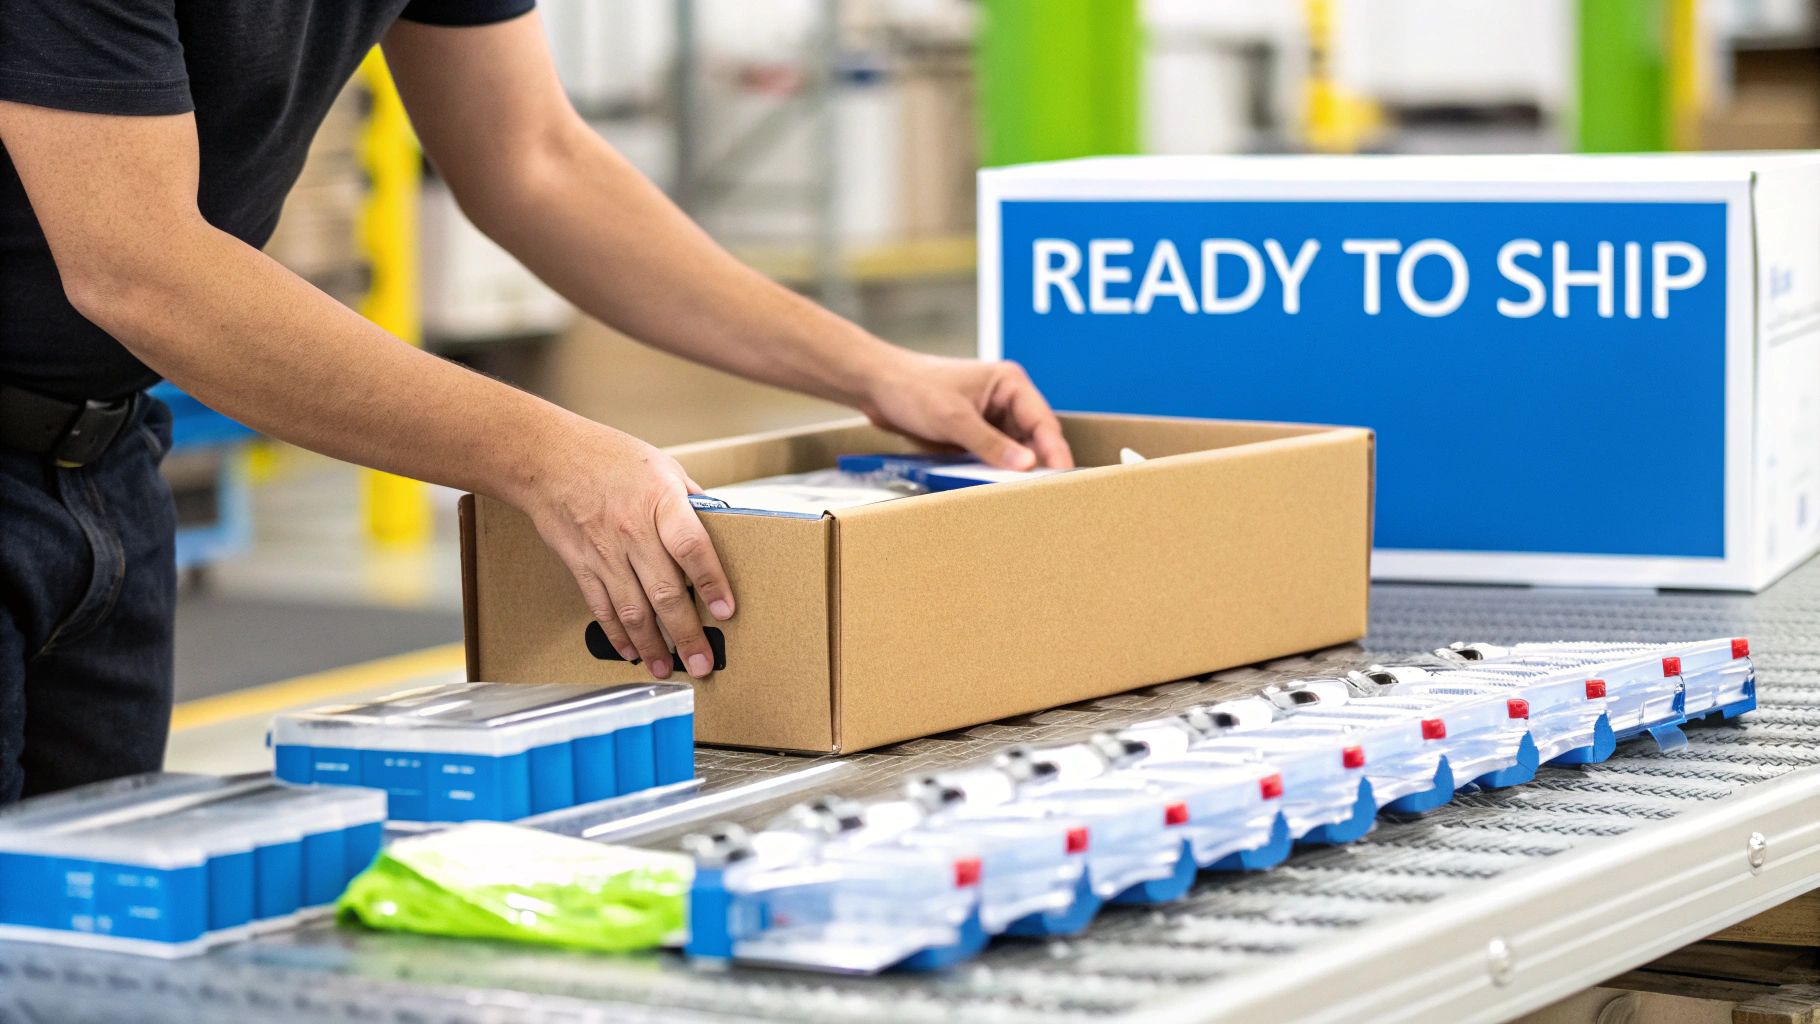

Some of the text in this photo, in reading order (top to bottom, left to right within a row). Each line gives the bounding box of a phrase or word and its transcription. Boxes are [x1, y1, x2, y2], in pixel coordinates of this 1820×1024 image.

[1033, 239, 1320, 314] READY
[1343, 239, 1469, 317] TO
[1497, 240, 1707, 319] SHIP
